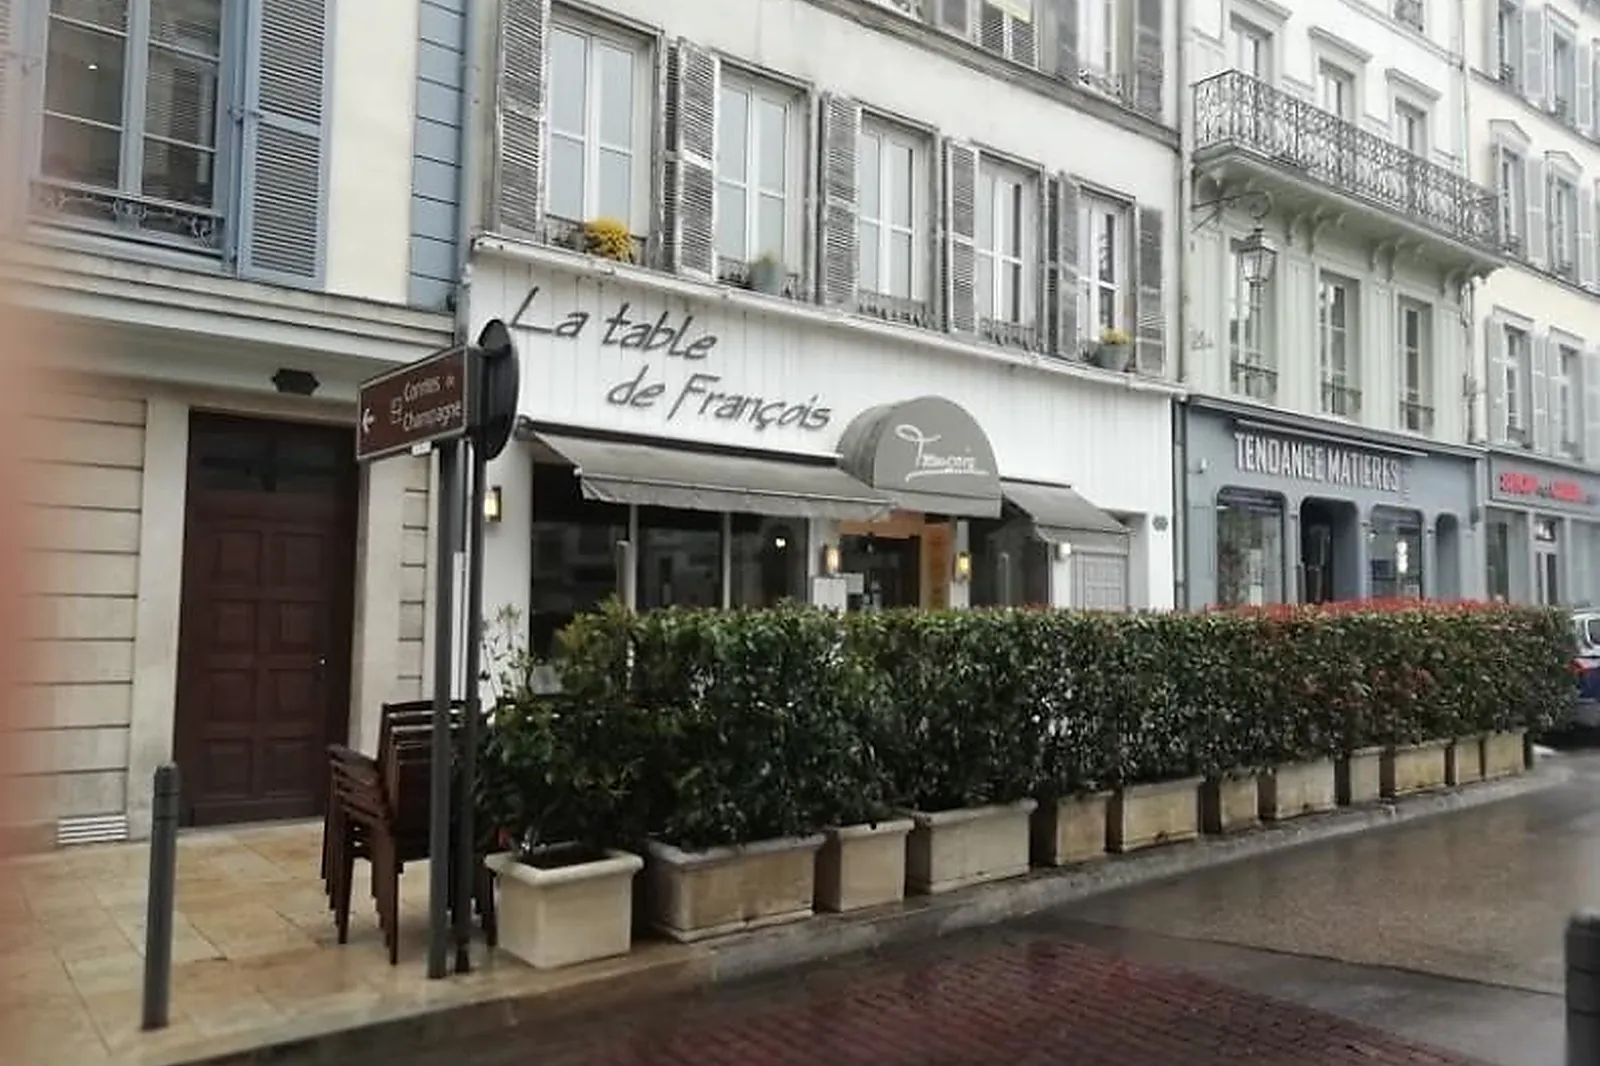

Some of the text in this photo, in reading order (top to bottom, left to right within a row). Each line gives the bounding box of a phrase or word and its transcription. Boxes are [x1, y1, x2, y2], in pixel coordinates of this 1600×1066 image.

[508, 285, 719, 360] La table
[605, 364, 833, 431] de François
[1234, 432, 1325, 483] TENDANCE
